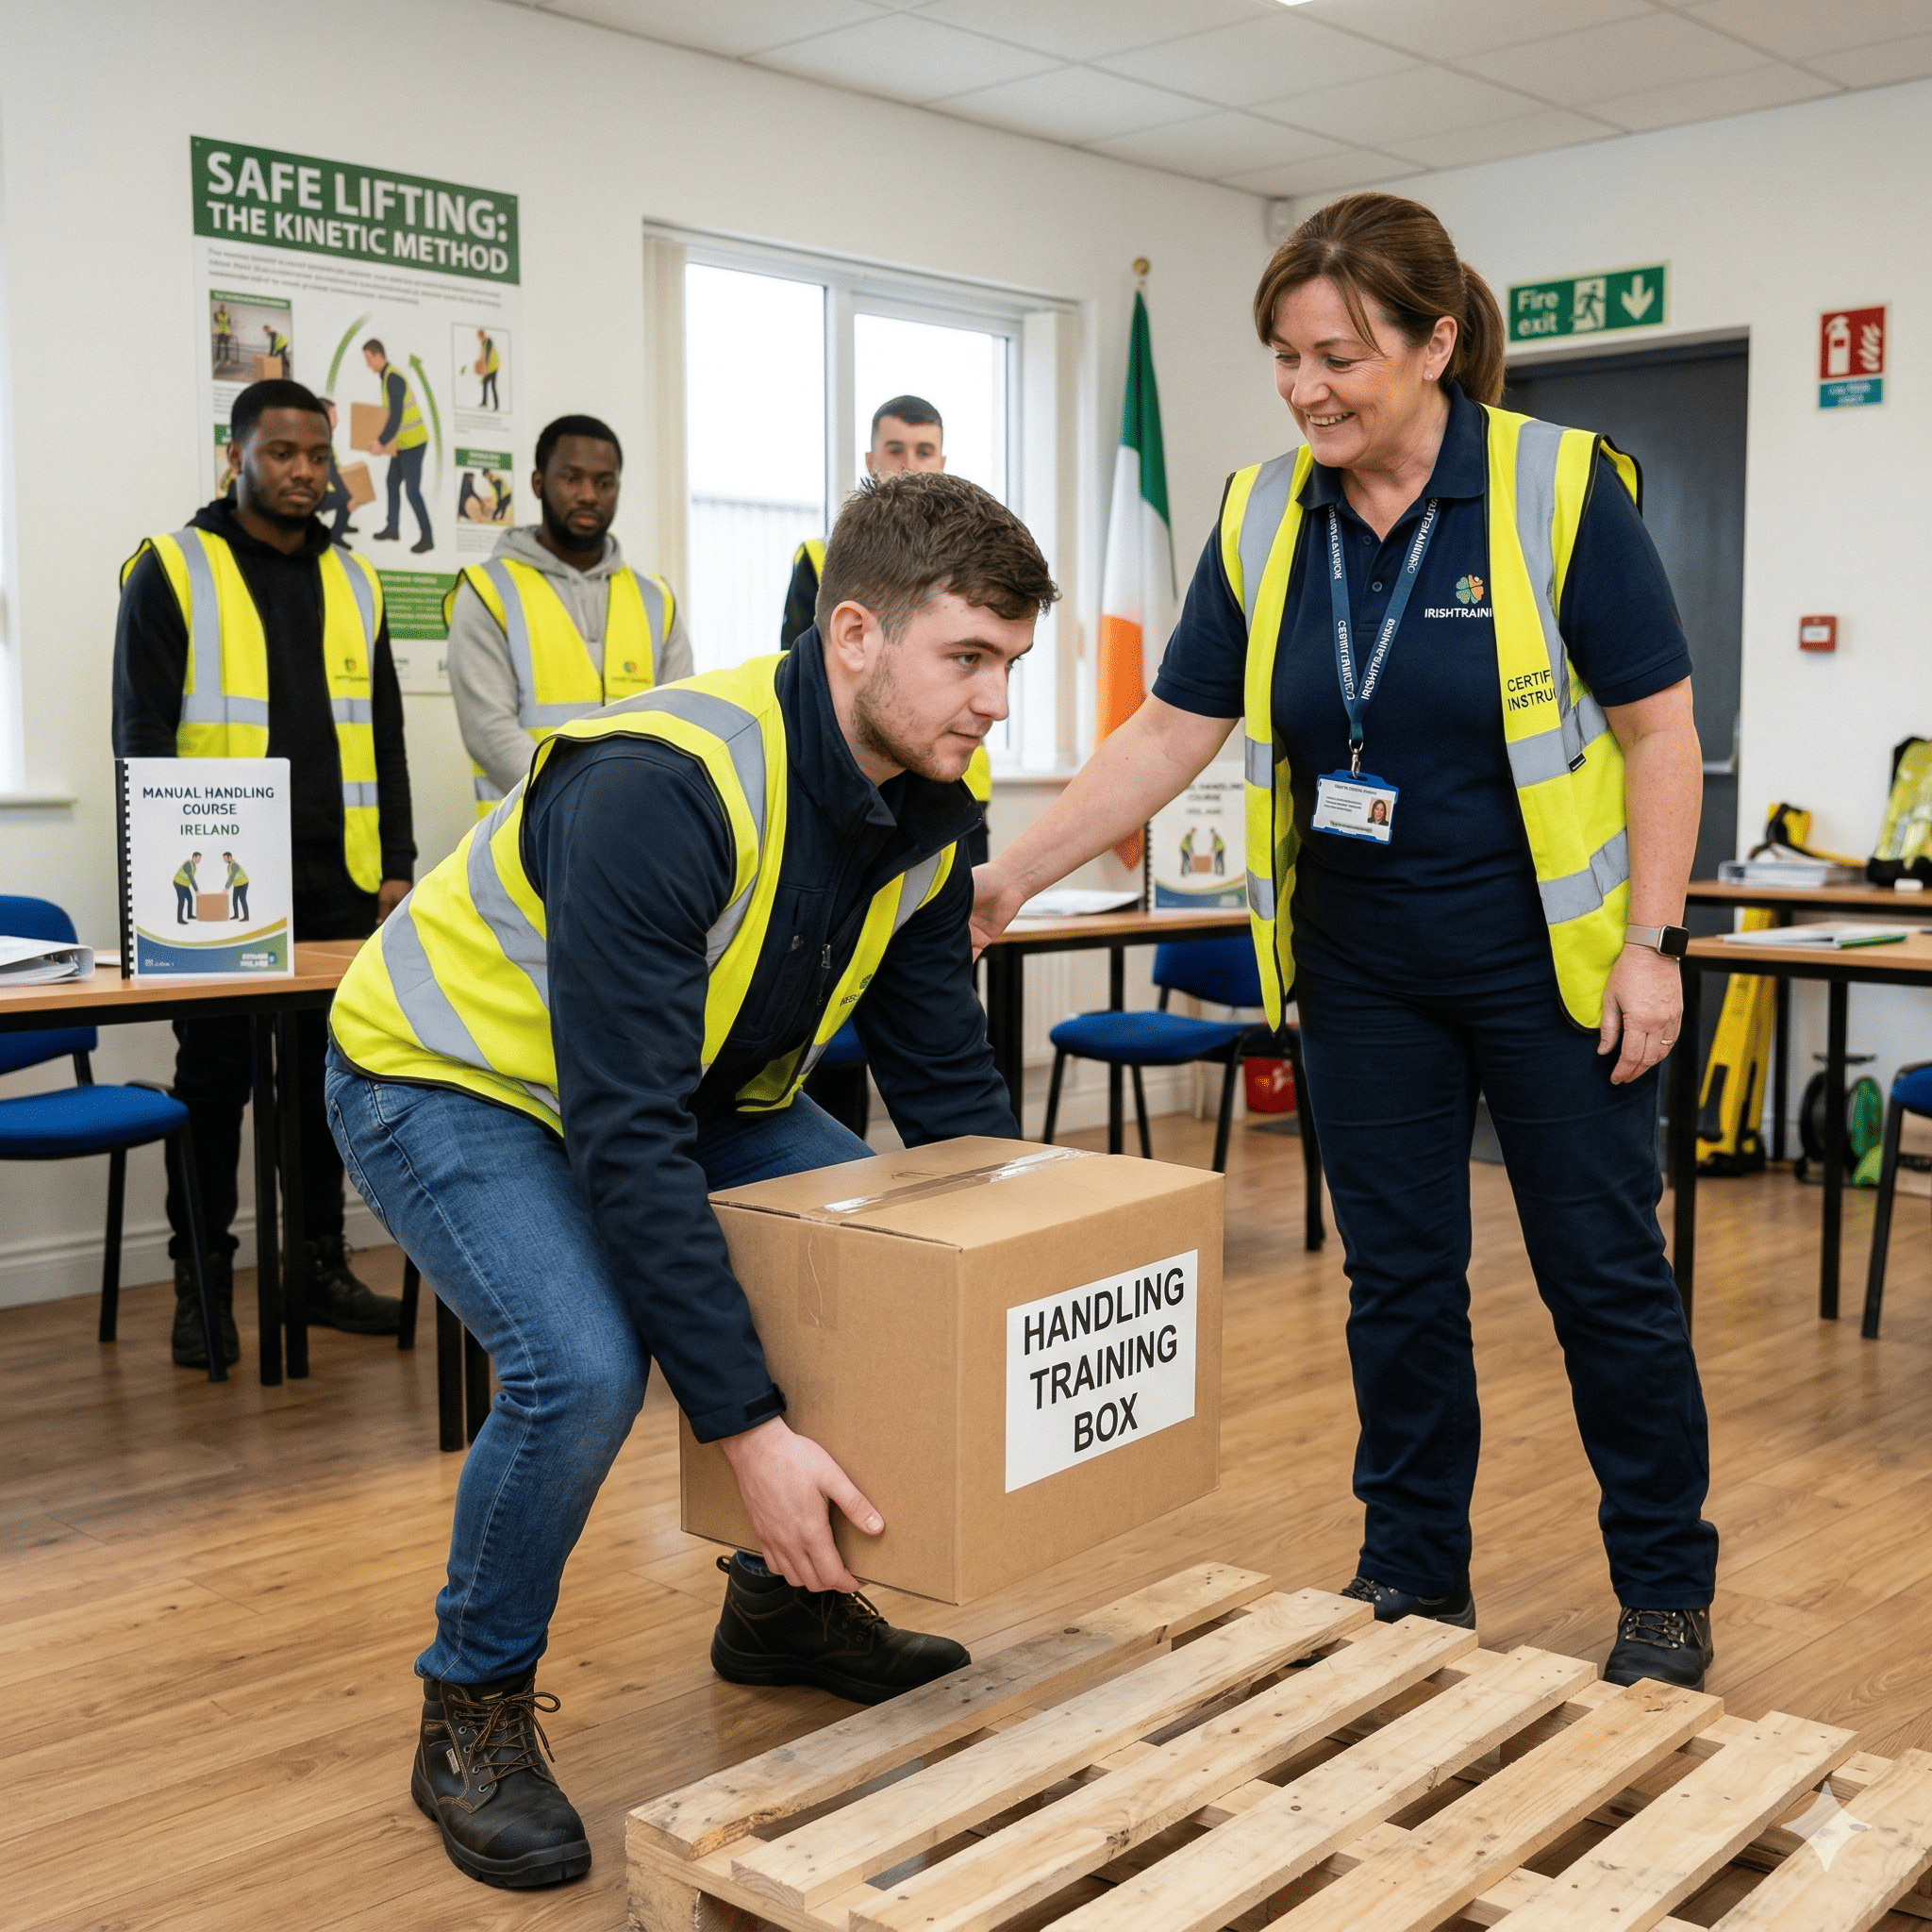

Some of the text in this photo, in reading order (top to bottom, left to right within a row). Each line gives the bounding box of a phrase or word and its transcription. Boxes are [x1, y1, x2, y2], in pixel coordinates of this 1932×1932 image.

[207, 151, 508, 243] SAFE LIFTING:
[206, 200, 509, 275] THE KINETIC METHOD
[1517, 288, 1560, 312] Fire
[1507, 669, 1551, 692] CERTIF
[142, 787, 275, 799] MANUAL HANDLING
[182, 803, 238, 815] COURSE
[179, 824, 241, 836] IRELAND
[1024, 1267, 1185, 1356] HANDLING
[1029, 1324, 1178, 1410] TRAINING
[1074, 1391, 1139, 1454] BOX
